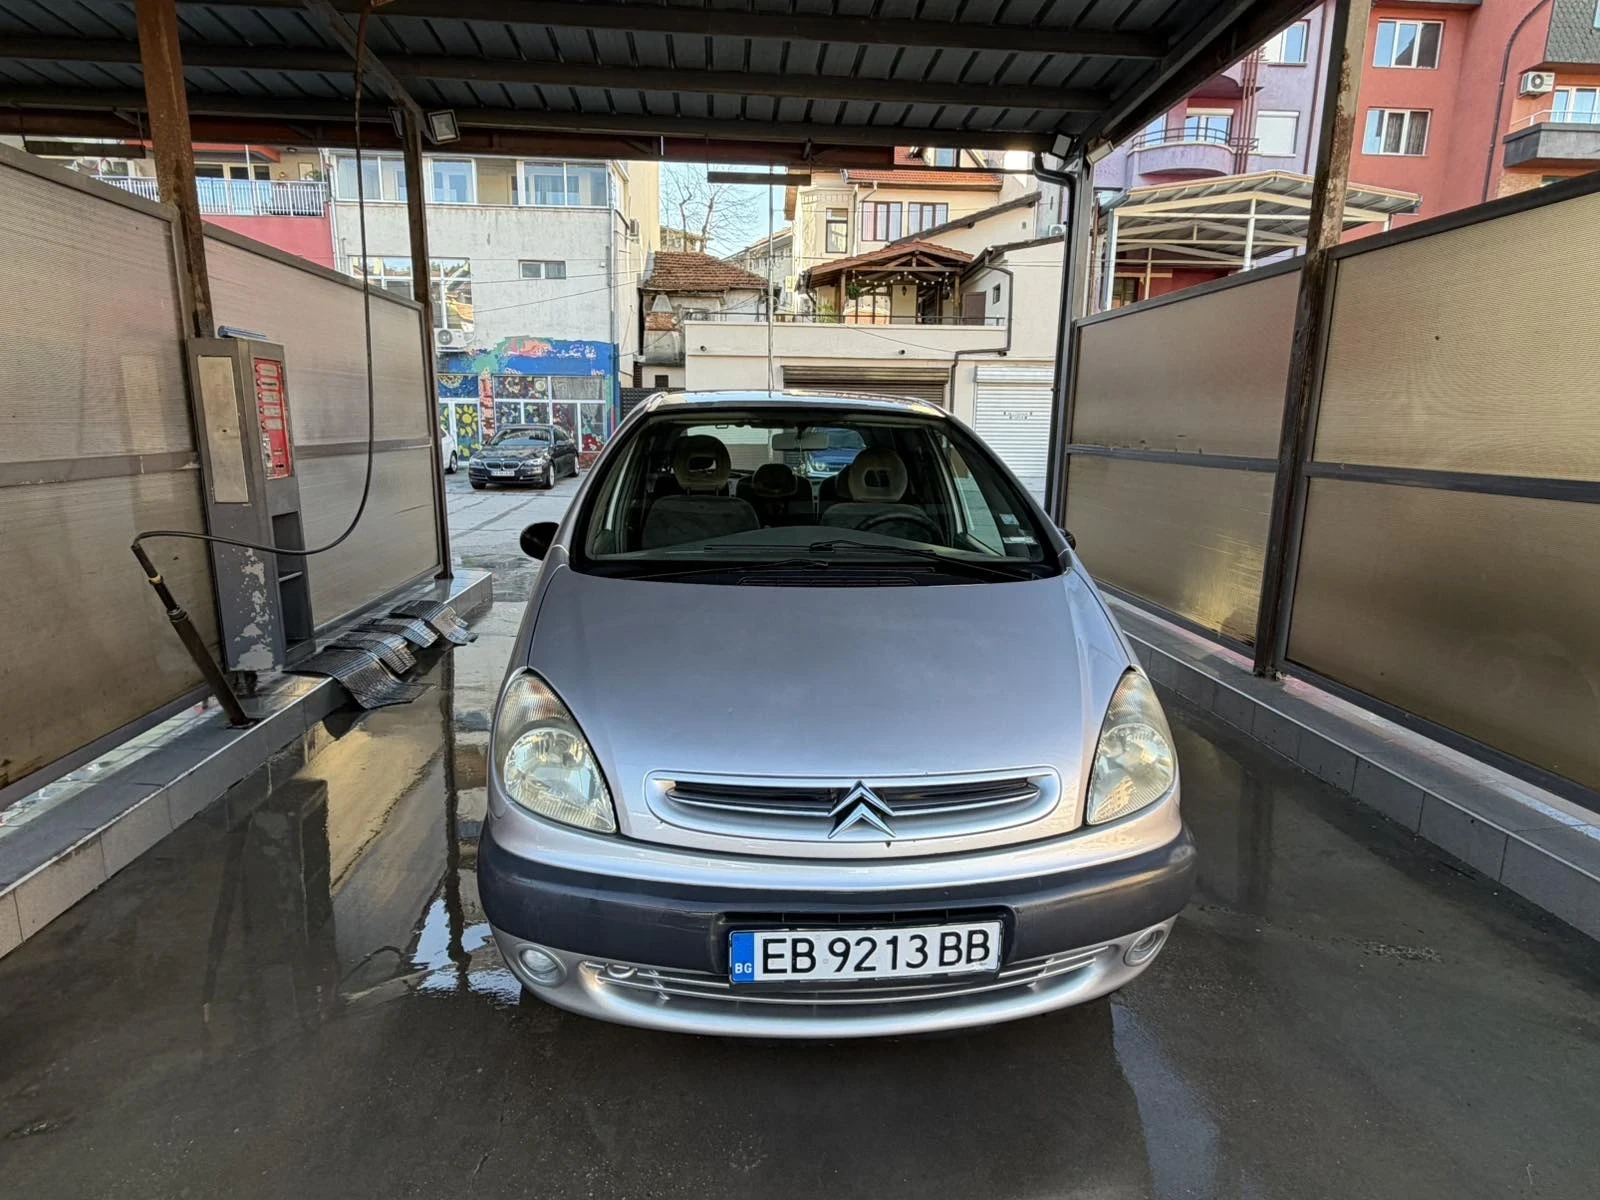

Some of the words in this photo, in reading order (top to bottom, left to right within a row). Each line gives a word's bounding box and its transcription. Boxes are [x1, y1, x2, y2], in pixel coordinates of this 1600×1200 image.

[762, 937, 817, 975] EB
[828, 933, 929, 973] 9213
[938, 928, 990, 968] BB
[734, 962, 753, 975] BG
